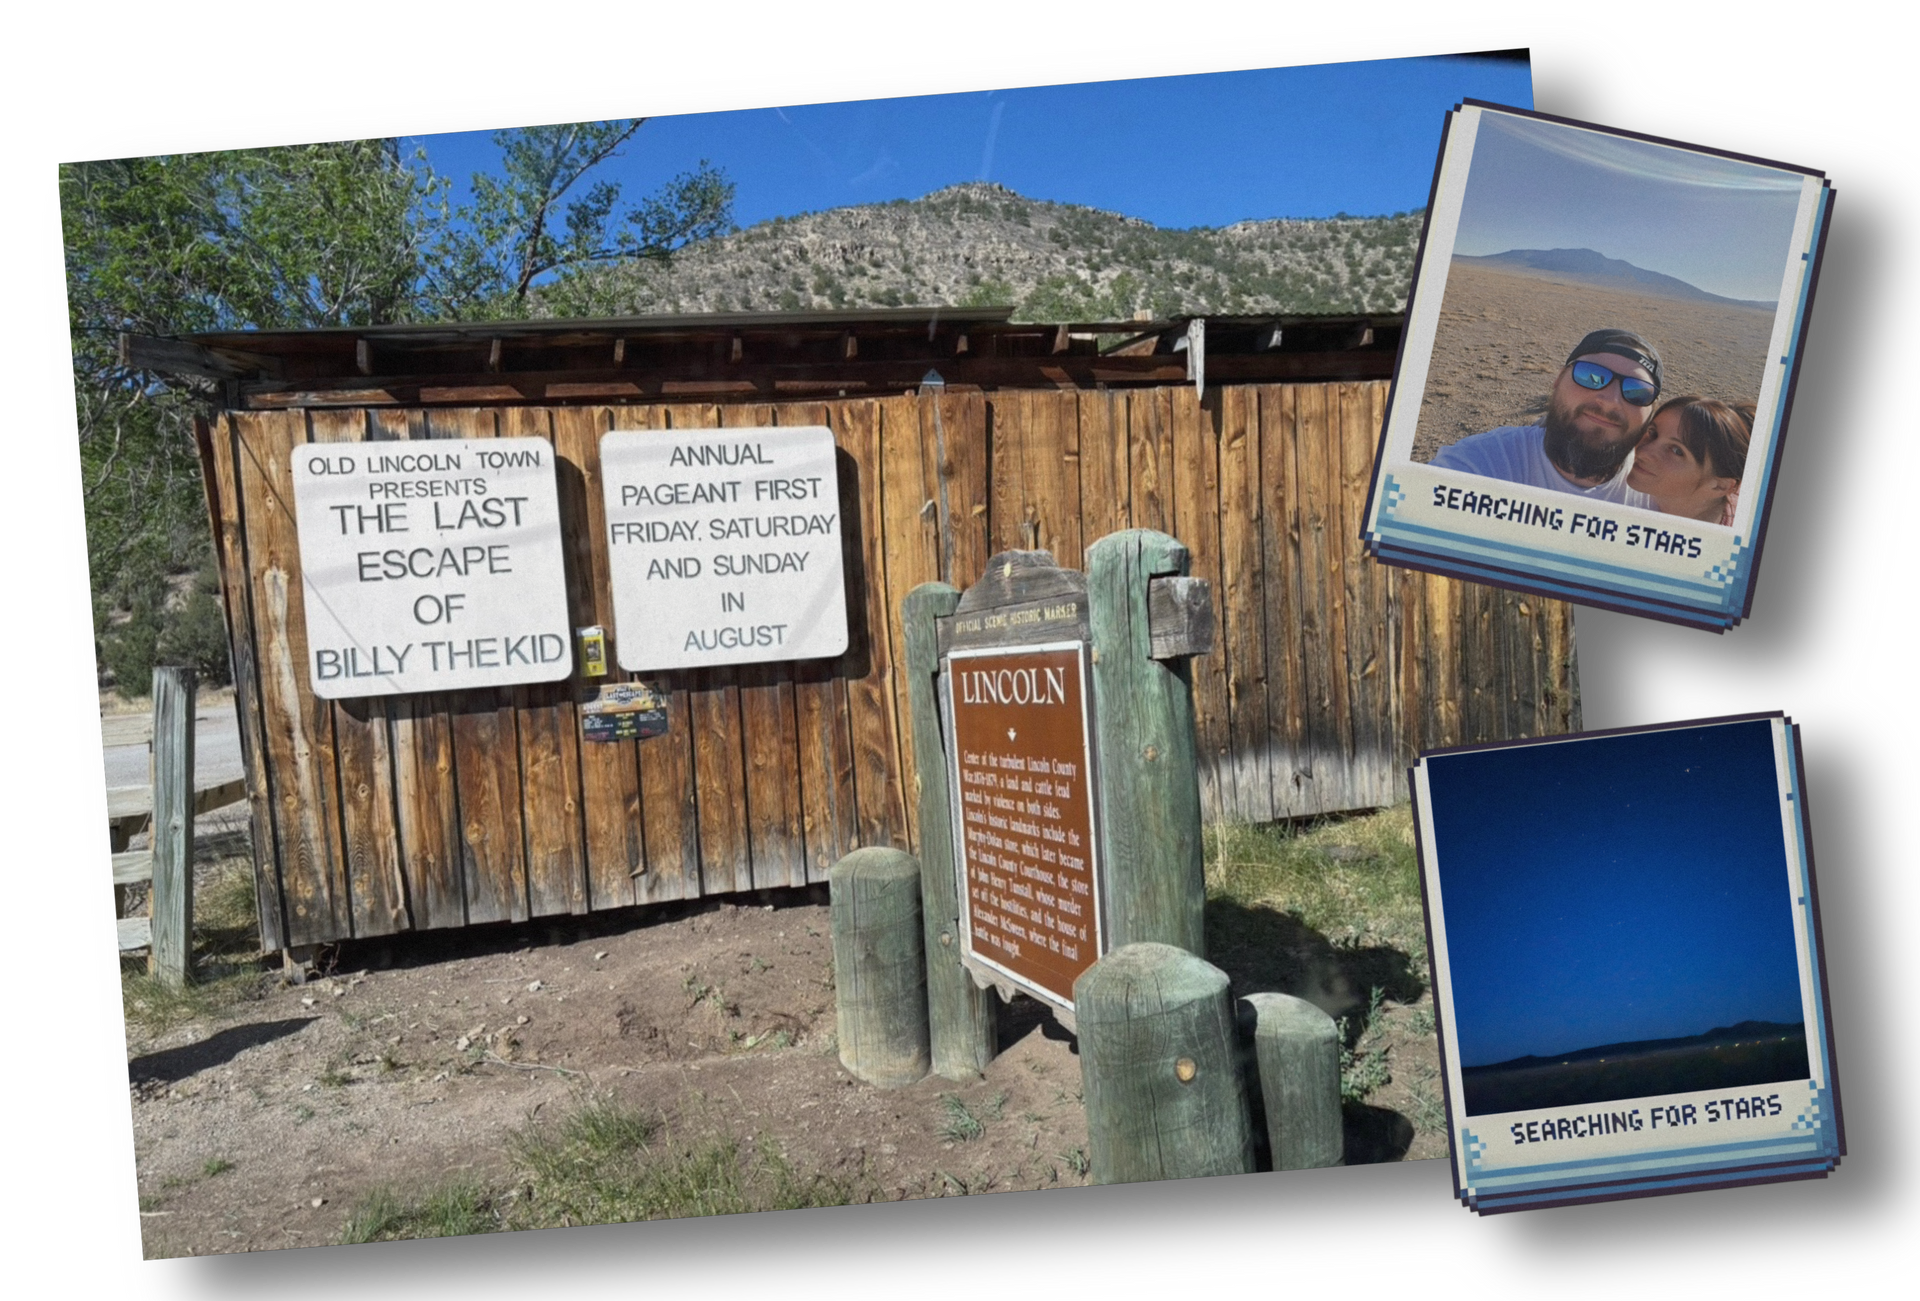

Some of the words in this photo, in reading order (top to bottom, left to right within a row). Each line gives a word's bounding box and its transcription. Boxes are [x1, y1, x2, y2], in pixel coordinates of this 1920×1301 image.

[308, 456, 355, 475] OLD
[368, 454, 461, 473] LINCOLN
[476, 450, 541, 470] TOWN
[670, 444, 774, 468] ANNUAL
[369, 478, 487, 500] PRESENTS
[621, 481, 742, 506] PAGEANT
[754, 478, 822, 501] FIRST
[330, 502, 410, 535] THE
[434, 497, 529, 530] LAST
[709, 514, 836, 540] SATURDAY
[357, 544, 512, 582] ESCAPE
[646, 557, 702, 580] AND
[713, 552, 810, 576] SUNDAY
[413, 594, 466, 625] OF
[721, 592, 745, 613] IN
[956, 618, 982, 634] OFFICIAL
[984, 614, 1007, 630] SCENIC
[1010, 608, 1041, 624] HISTORIC
[1044, 602, 1078, 621] MARKER
[684, 624, 788, 652] AUGUST
[316, 643, 413, 680] BILLY
[422, 638, 500, 672] THE
[504, 633, 565, 666] KID
[961, 667, 1065, 705] LINCOLN
[964, 750, 980, 765] Center
[989, 752, 998, 768] the
[1000, 753, 1026, 770] turbulent
[1027, 756, 1050, 773] Lincoln
[1052, 758, 1076, 781] County
[1006, 774, 1019, 791] land
[1022, 777, 1032, 793] and
[1034, 779, 1052, 796] cattle
[964, 788, 982, 804] marked
[993, 794, 1015, 811] violence
[1017, 800, 1024, 812] on
[1026, 798, 1042, 816] both
[988, 810, 1008, 829] historic
[1010, 816, 1040, 837] landmarks
[1042, 824, 1066, 843] include
[1068, 828, 1080, 847] the
[969, 845, 977, 860] the
[978, 848, 997, 867] Lincoln
[998, 854, 1018, 878] County
[1058, 871, 1068, 890] the
[1022, 840, 1040, 859] which
[1041, 844, 1056, 864] later
[1058, 848, 1084, 871] became
[990, 890, 999, 908] the
[1030, 908, 1042, 924] and
[1044, 910, 1055, 929] the
[1057, 914, 1076, 938] house
[1036, 887, 1055, 907] whose
[1058, 897, 1082, 917] murder
[990, 934, 1001, 948] was
[1029, 928, 1047, 948] where
[1049, 934, 1060, 952] the
[1062, 938, 1078, 961] final
